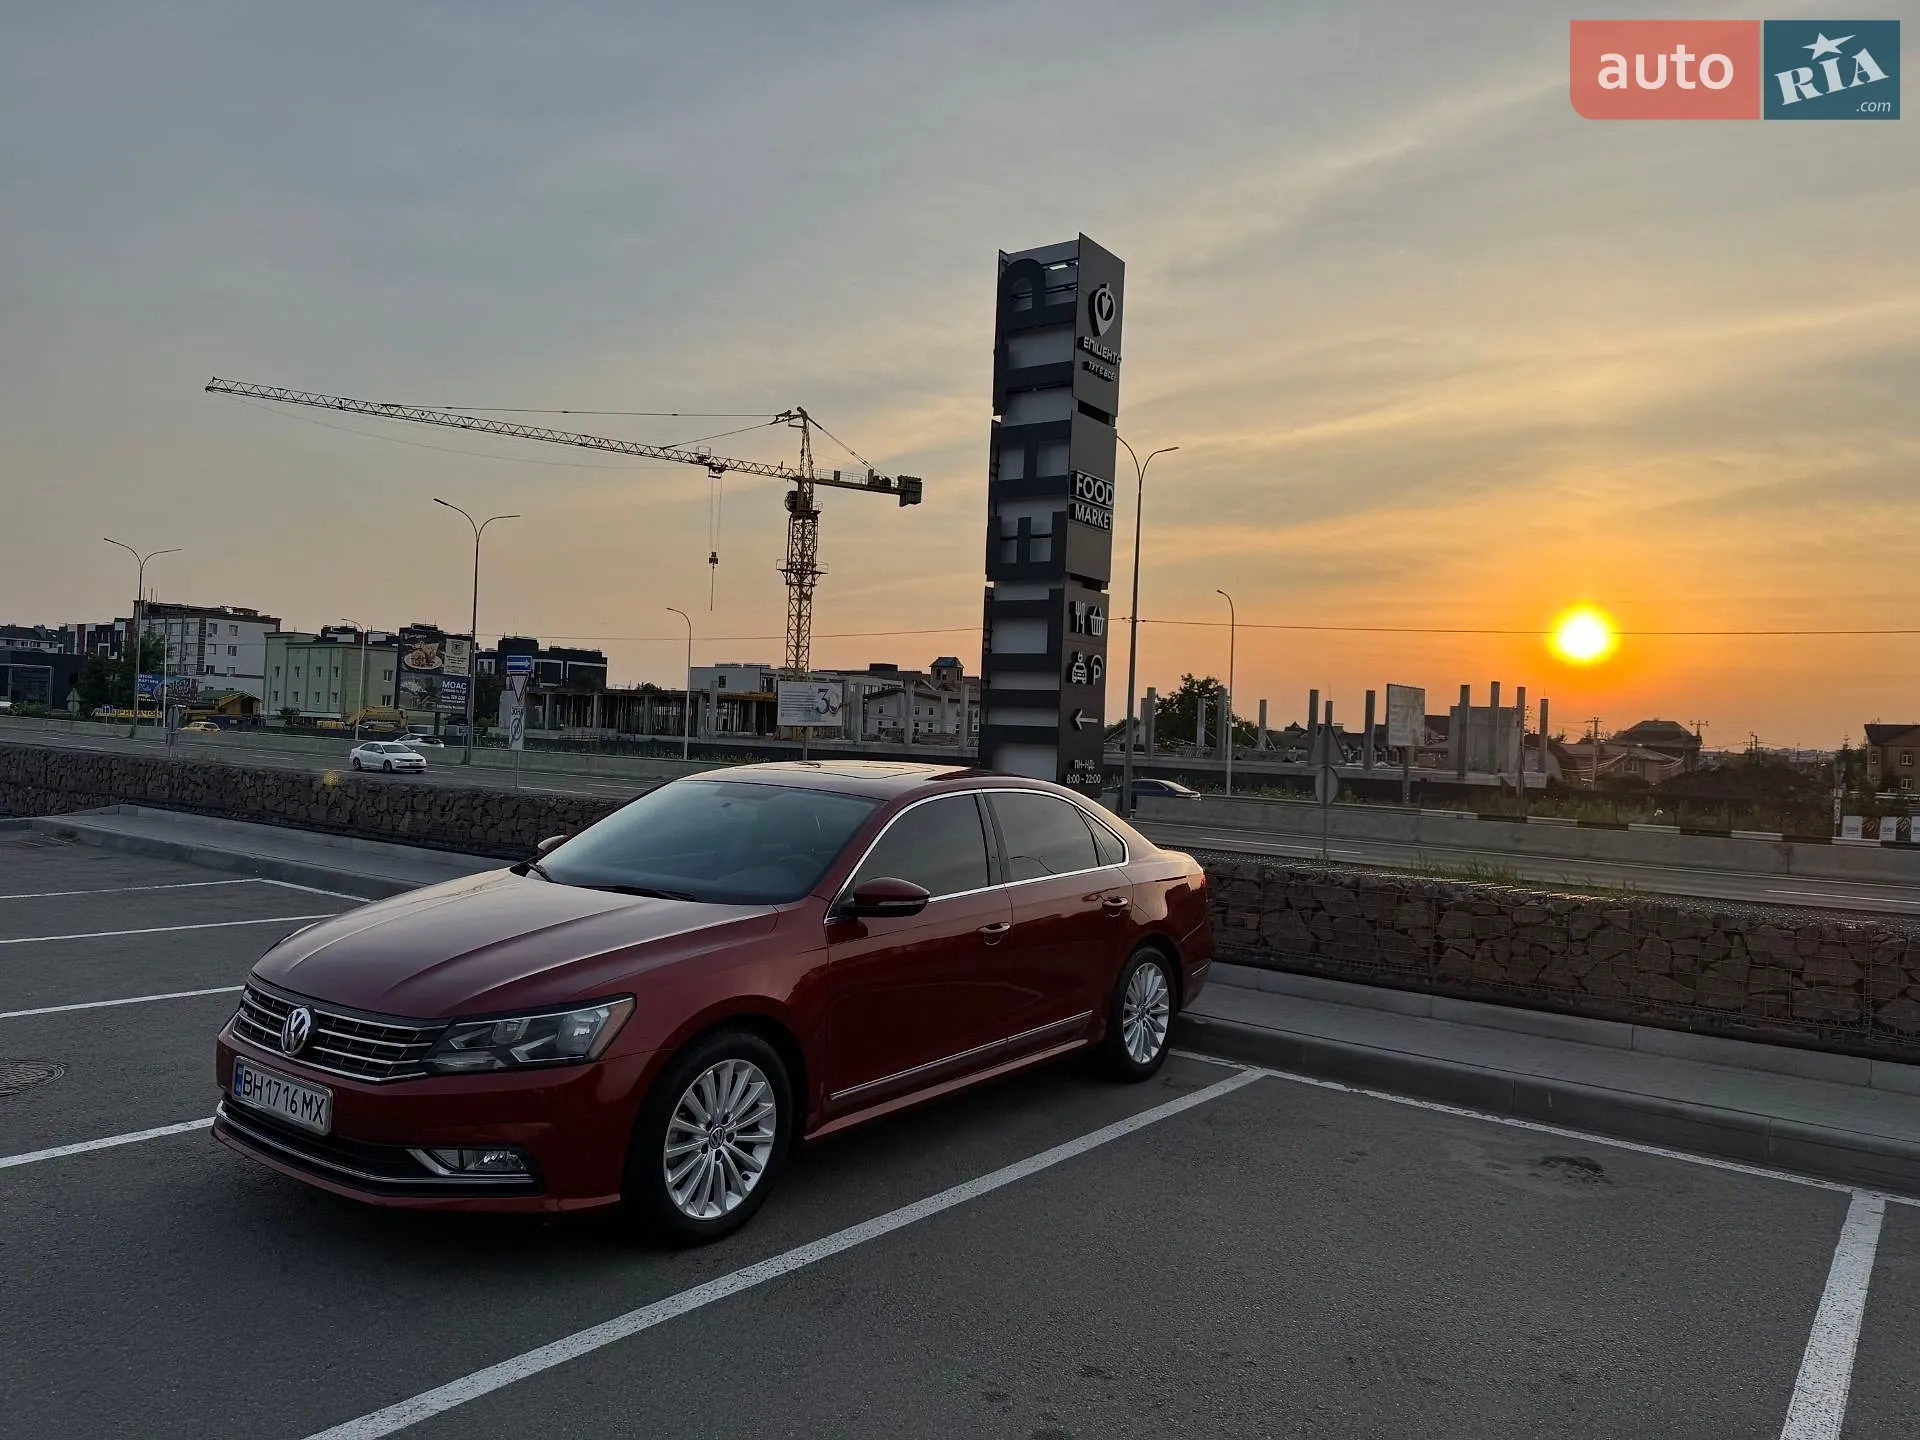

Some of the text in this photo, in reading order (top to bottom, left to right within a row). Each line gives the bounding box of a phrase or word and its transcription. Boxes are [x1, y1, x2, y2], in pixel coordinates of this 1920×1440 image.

[1075, 473, 1114, 505] FOOD
[1075, 503, 1113, 531] MARKET
[1085, 774, 1101, 784] 22:00
